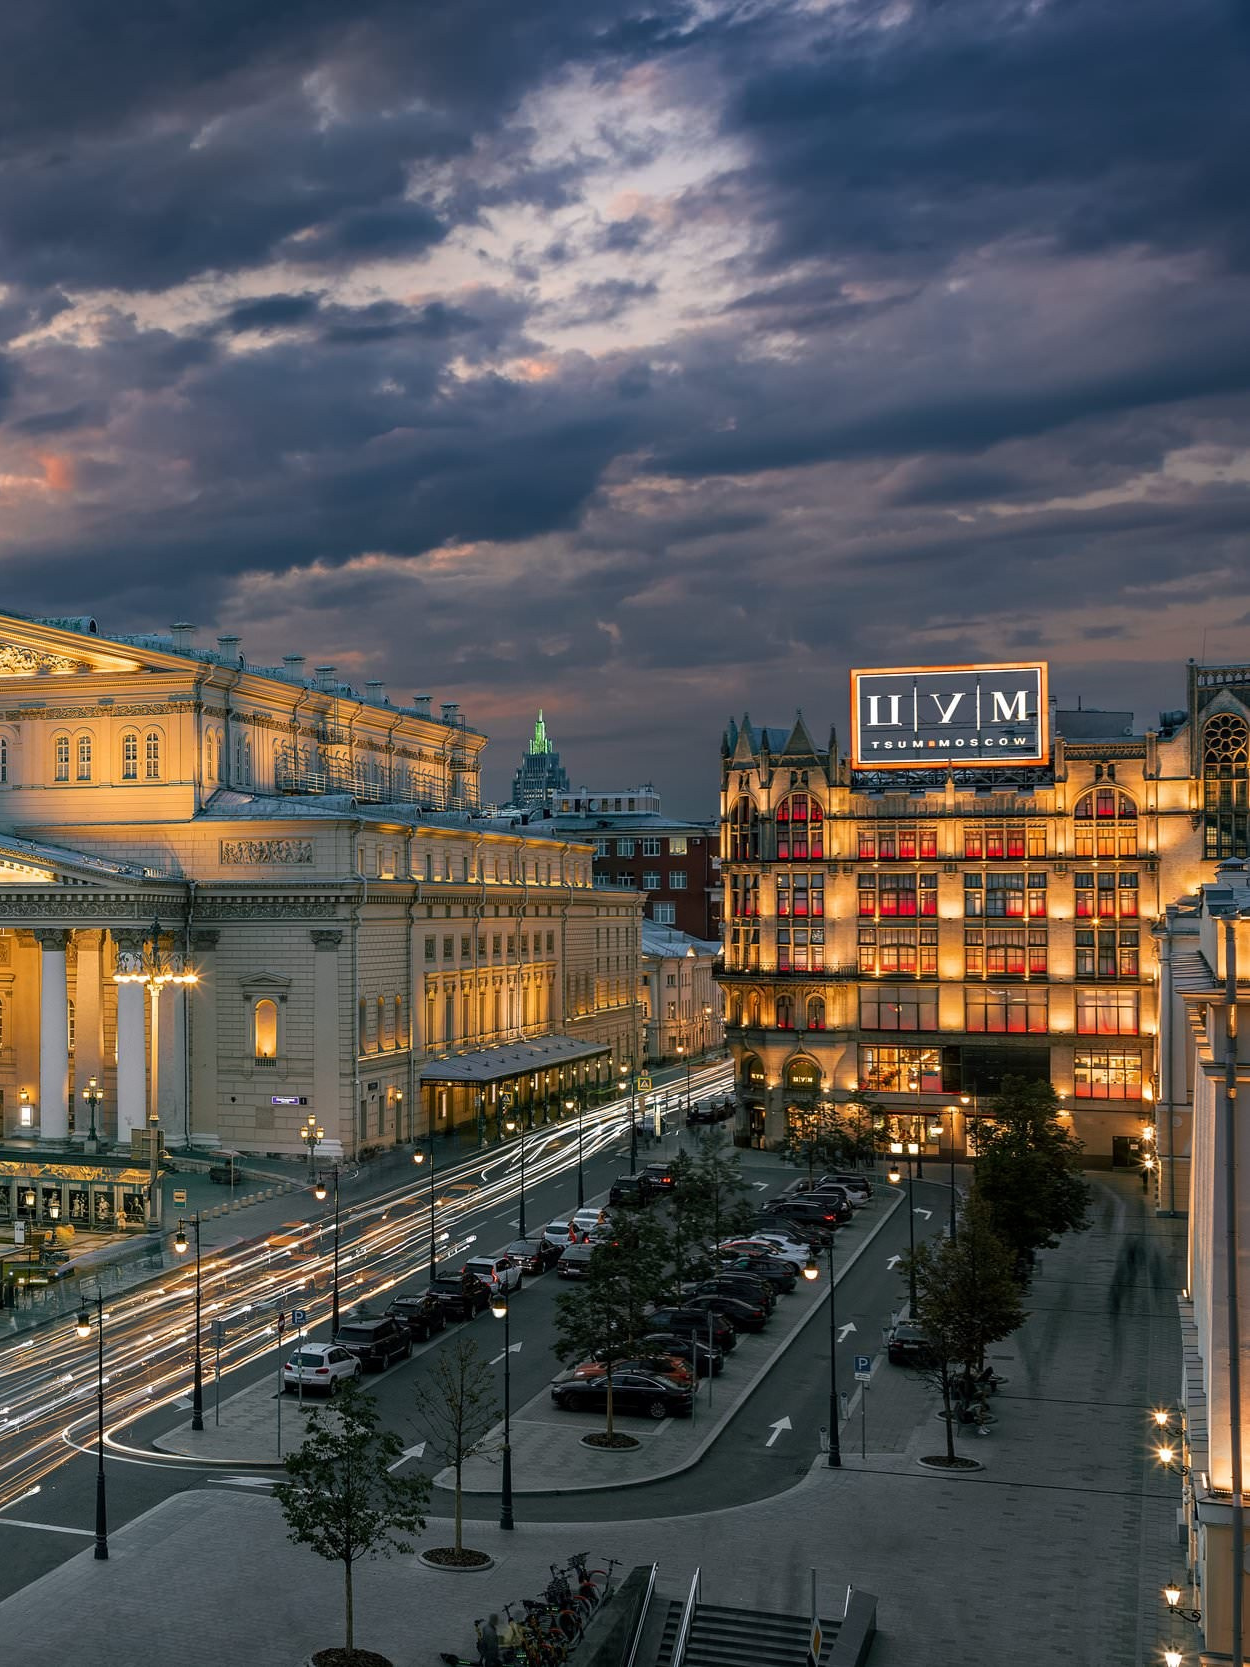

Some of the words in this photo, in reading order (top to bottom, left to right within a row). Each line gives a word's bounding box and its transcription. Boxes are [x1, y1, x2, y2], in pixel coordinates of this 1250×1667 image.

[871, 740, 924, 749] TSUM
[938, 737, 1026, 748] MOSCOW
[295, 1311, 304, 1323] P
[858, 1357, 868, 1370] P
